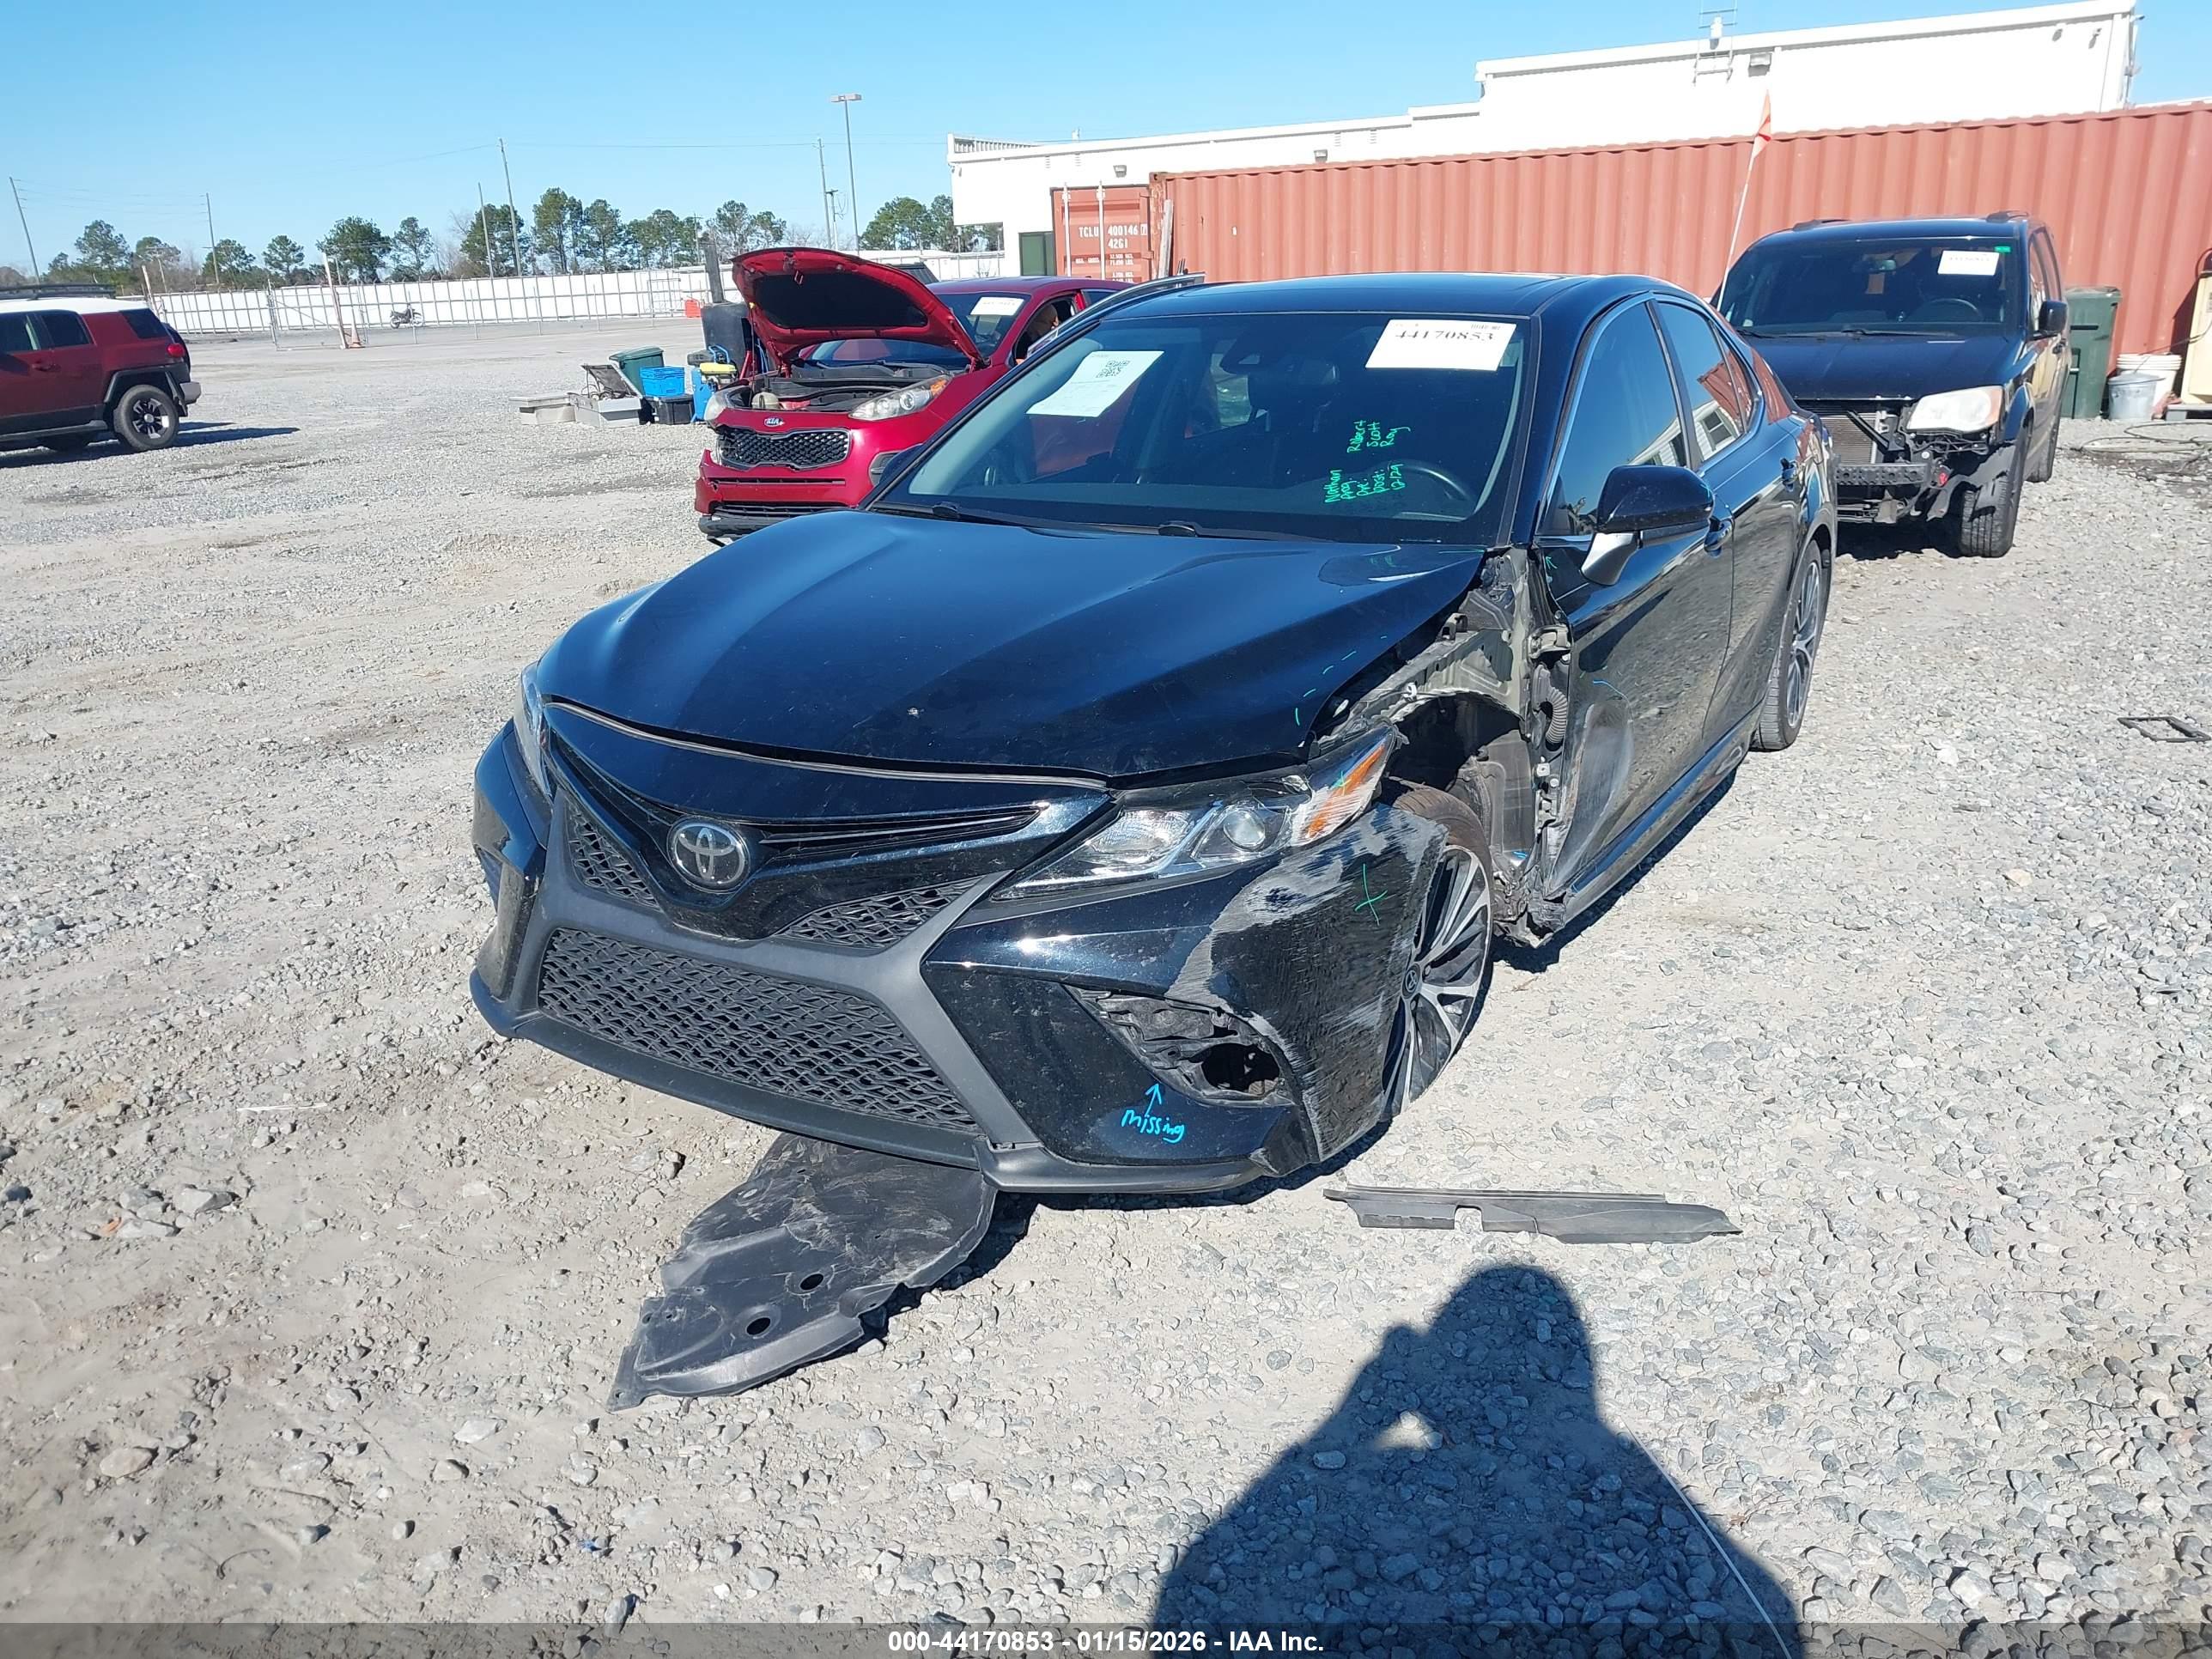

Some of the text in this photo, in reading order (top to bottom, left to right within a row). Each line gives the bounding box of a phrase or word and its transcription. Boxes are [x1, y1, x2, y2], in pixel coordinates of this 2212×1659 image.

[1079, 226, 1099, 237] TCLU
[1108, 224, 1139, 236] 400146
[1395, 330, 1495, 341] 44170853
